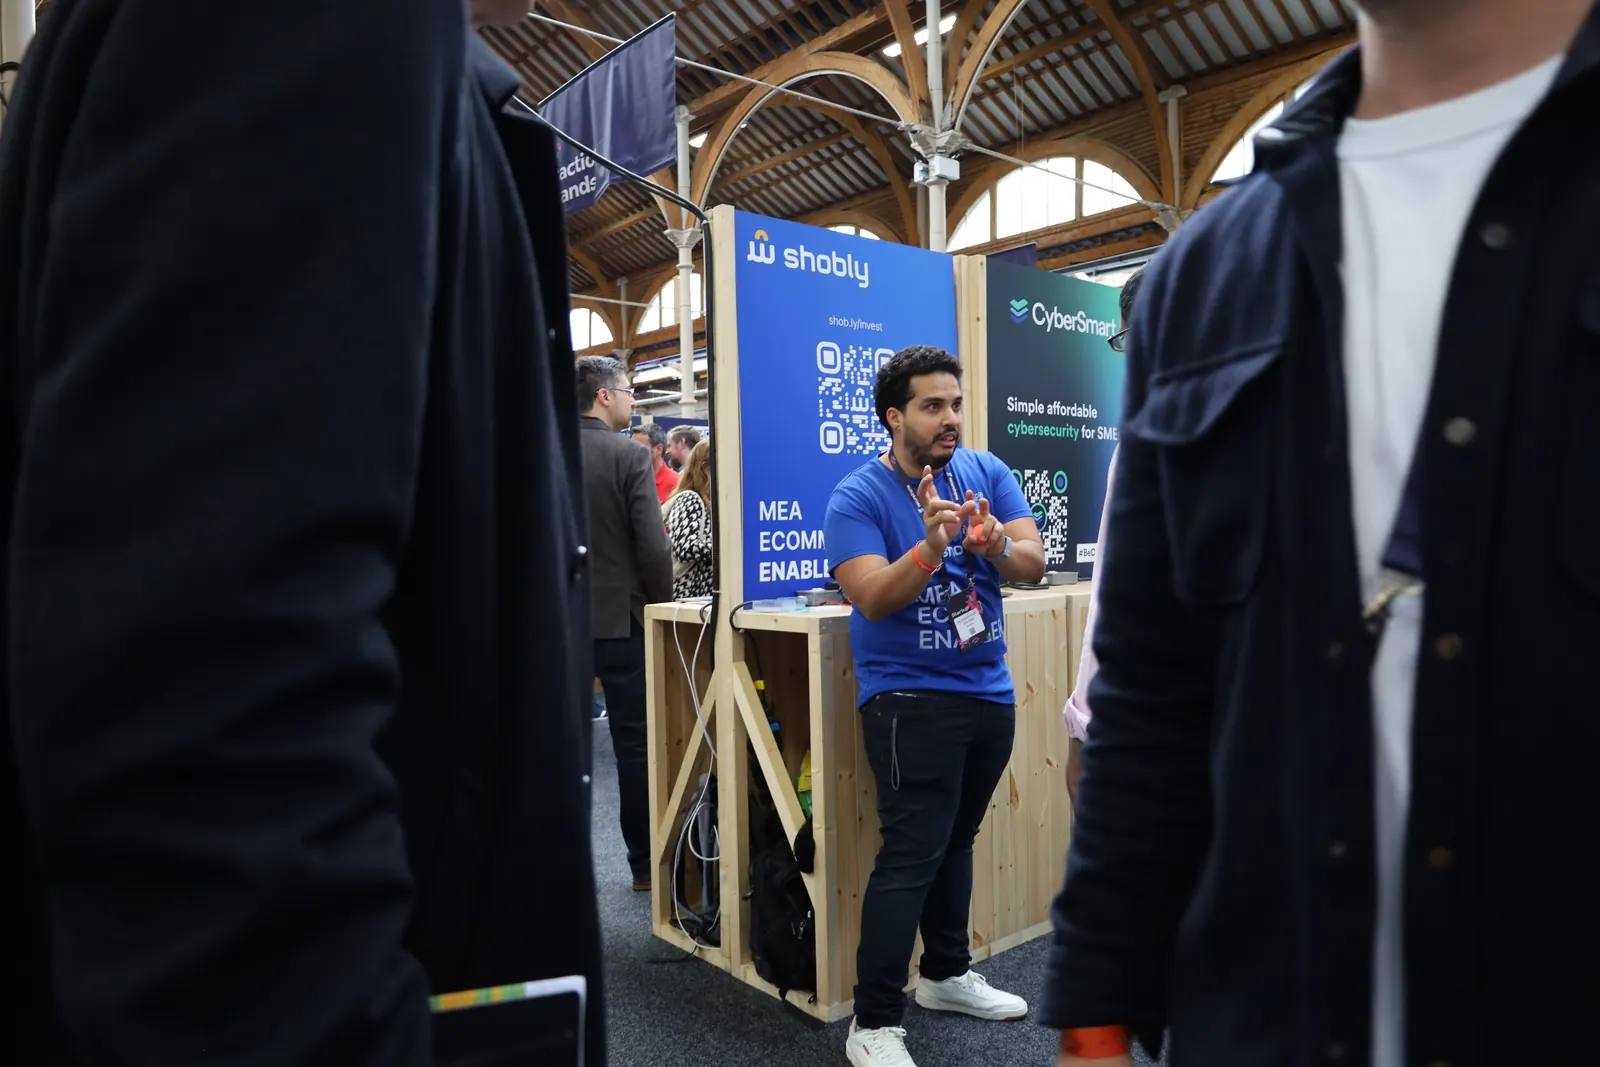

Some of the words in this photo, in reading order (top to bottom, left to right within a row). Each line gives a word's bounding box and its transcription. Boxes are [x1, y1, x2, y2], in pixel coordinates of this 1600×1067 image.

[783, 245, 869, 288] shobly
[828, 315, 883, 332] shob.ly/invest
[1032, 302, 1117, 337] CyberSmart
[1007, 396, 1045, 416] Simple
[1047, 401, 1098, 419] affordable
[1007, 420, 1079, 441] cybersecurity
[1081, 425, 1096, 439] for
[1097, 426, 1119, 440] SME
[759, 500, 803, 521] MEA
[1078, 547, 1096, 557] #BeC
